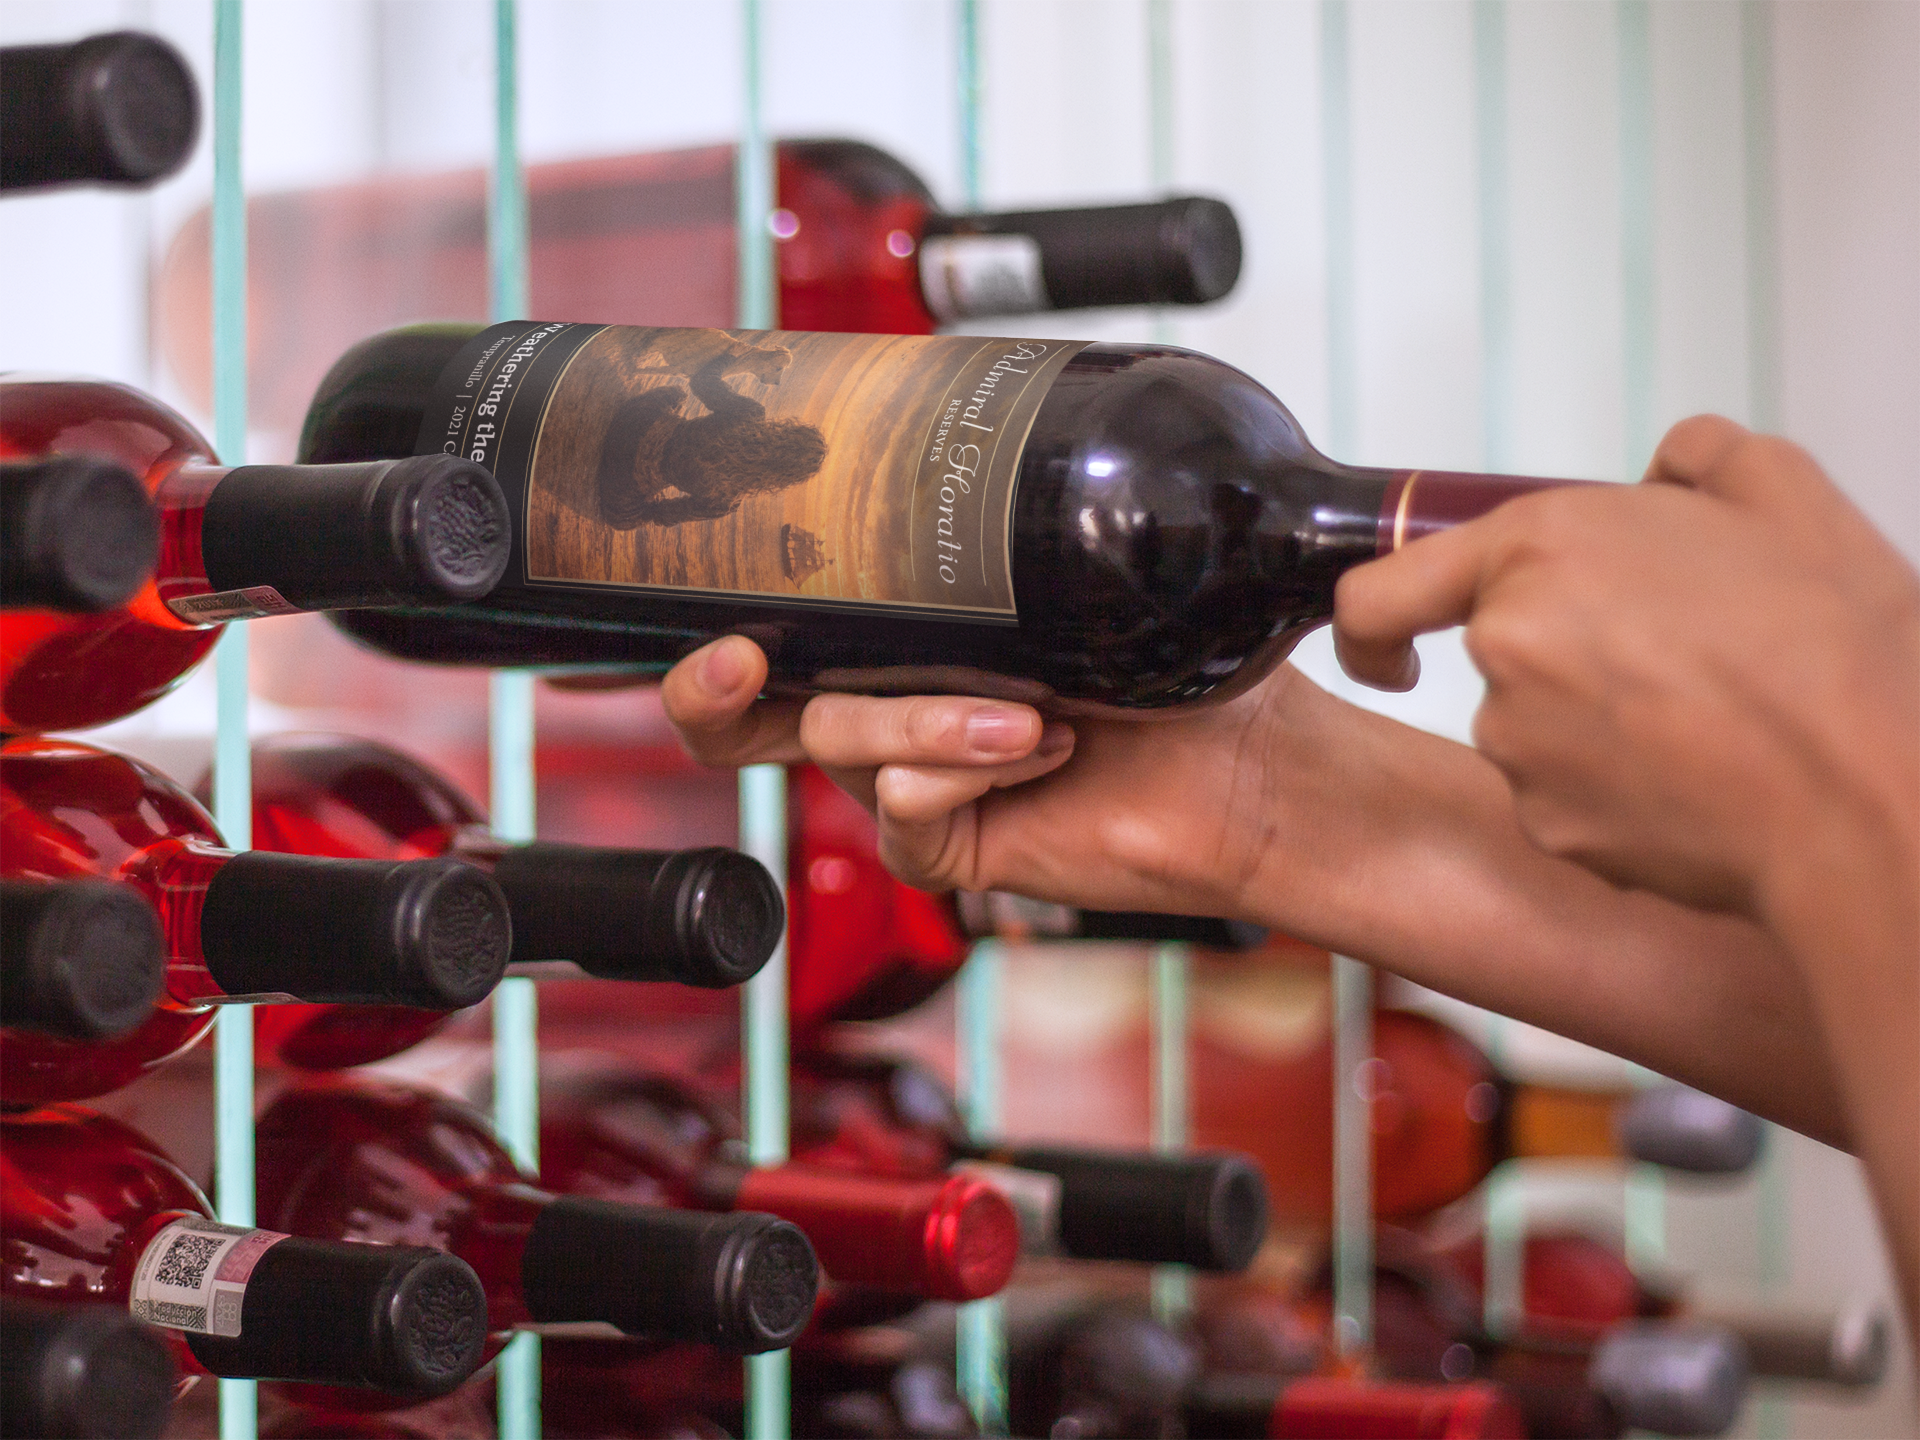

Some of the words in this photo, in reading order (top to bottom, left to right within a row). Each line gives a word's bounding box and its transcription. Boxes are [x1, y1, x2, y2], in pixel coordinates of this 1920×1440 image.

[464, 335, 516, 388] Tempranillo
[477, 322, 572, 417] Weathering
[959, 342, 1047, 433] Admiral
[447, 406, 467, 436] 2021
[470, 422, 496, 463] the
[930, 399, 962, 462] RESERVES
[937, 443, 981, 584] Horatio
